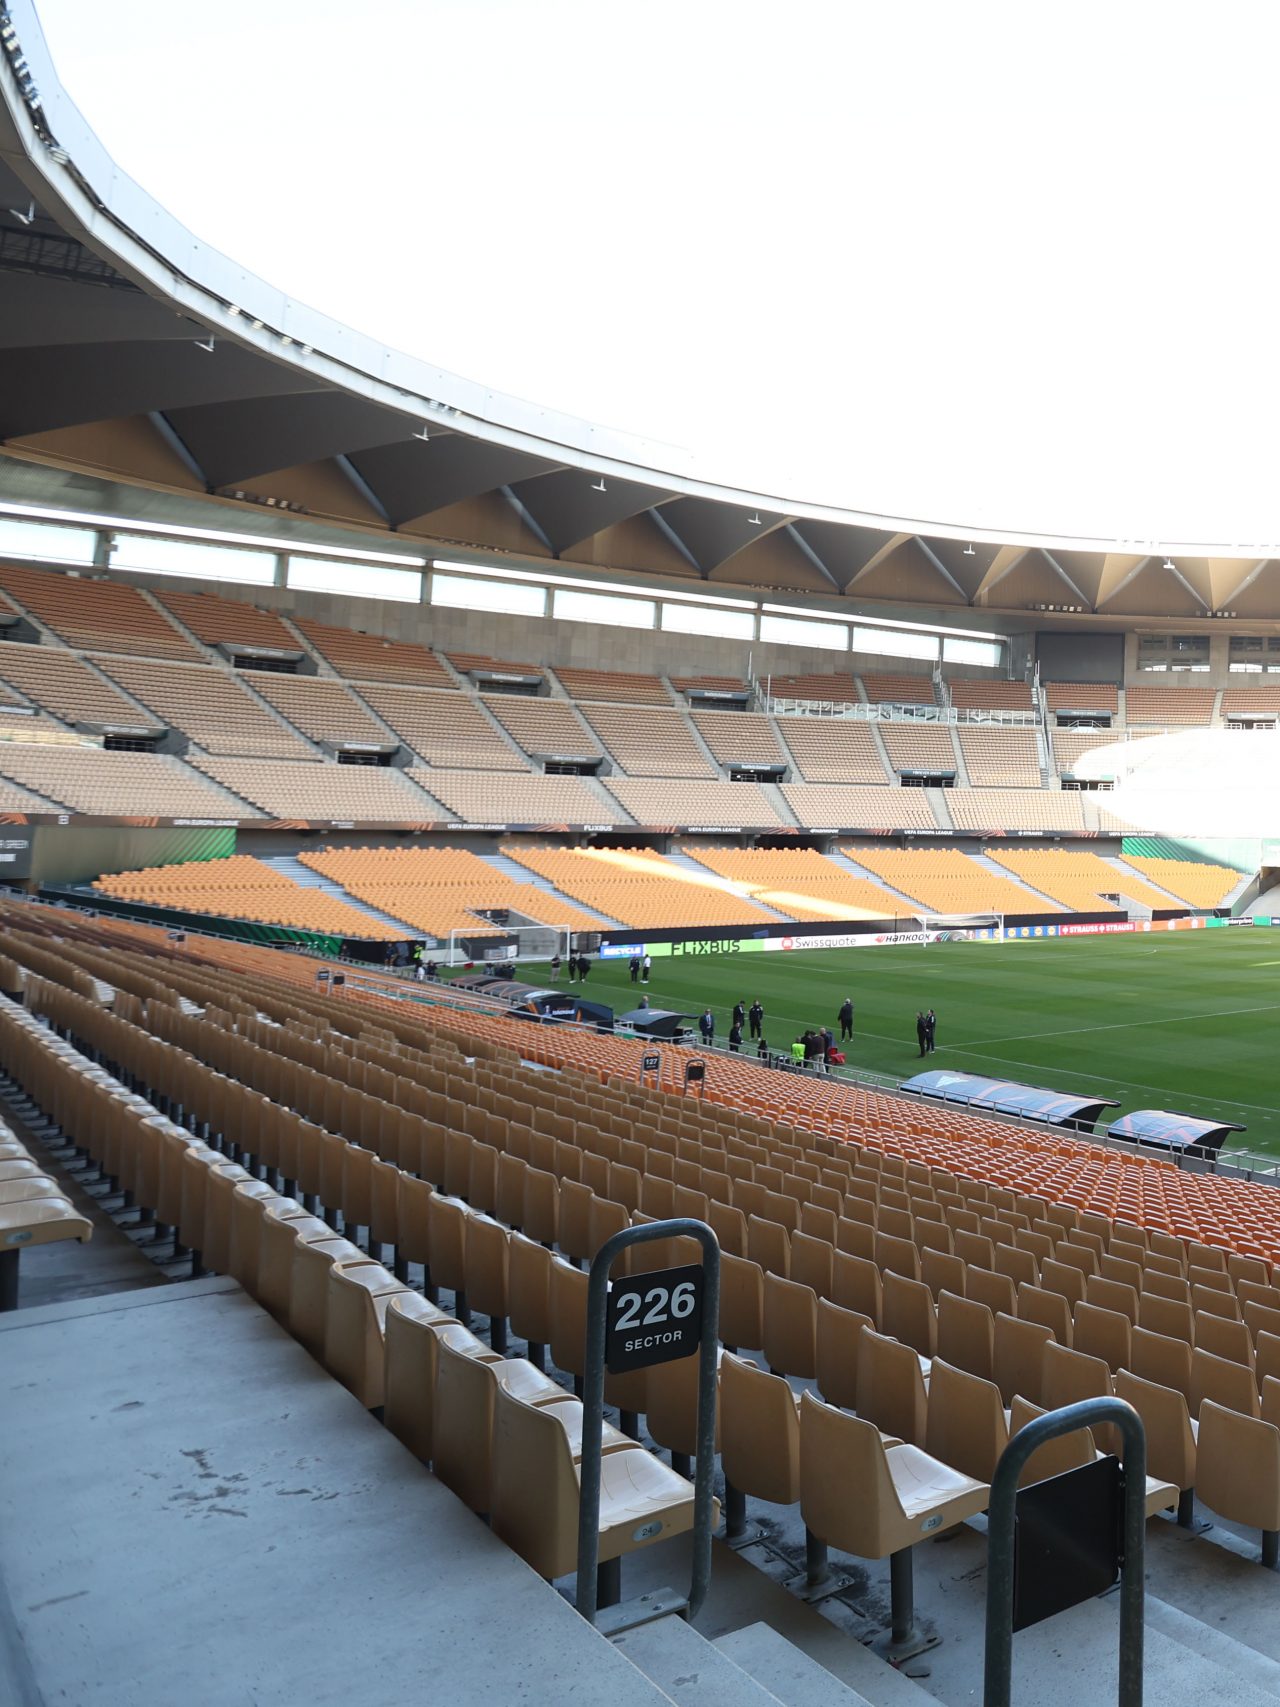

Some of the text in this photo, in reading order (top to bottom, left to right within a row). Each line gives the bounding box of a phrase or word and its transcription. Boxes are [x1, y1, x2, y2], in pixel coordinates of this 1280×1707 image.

[1069, 923, 1134, 933] STRAUSS STRAUSS
[795, 937, 856, 948] Swissquote
[615, 1282, 695, 1331] 226
[625, 1330, 682, 1351] SECTOR
